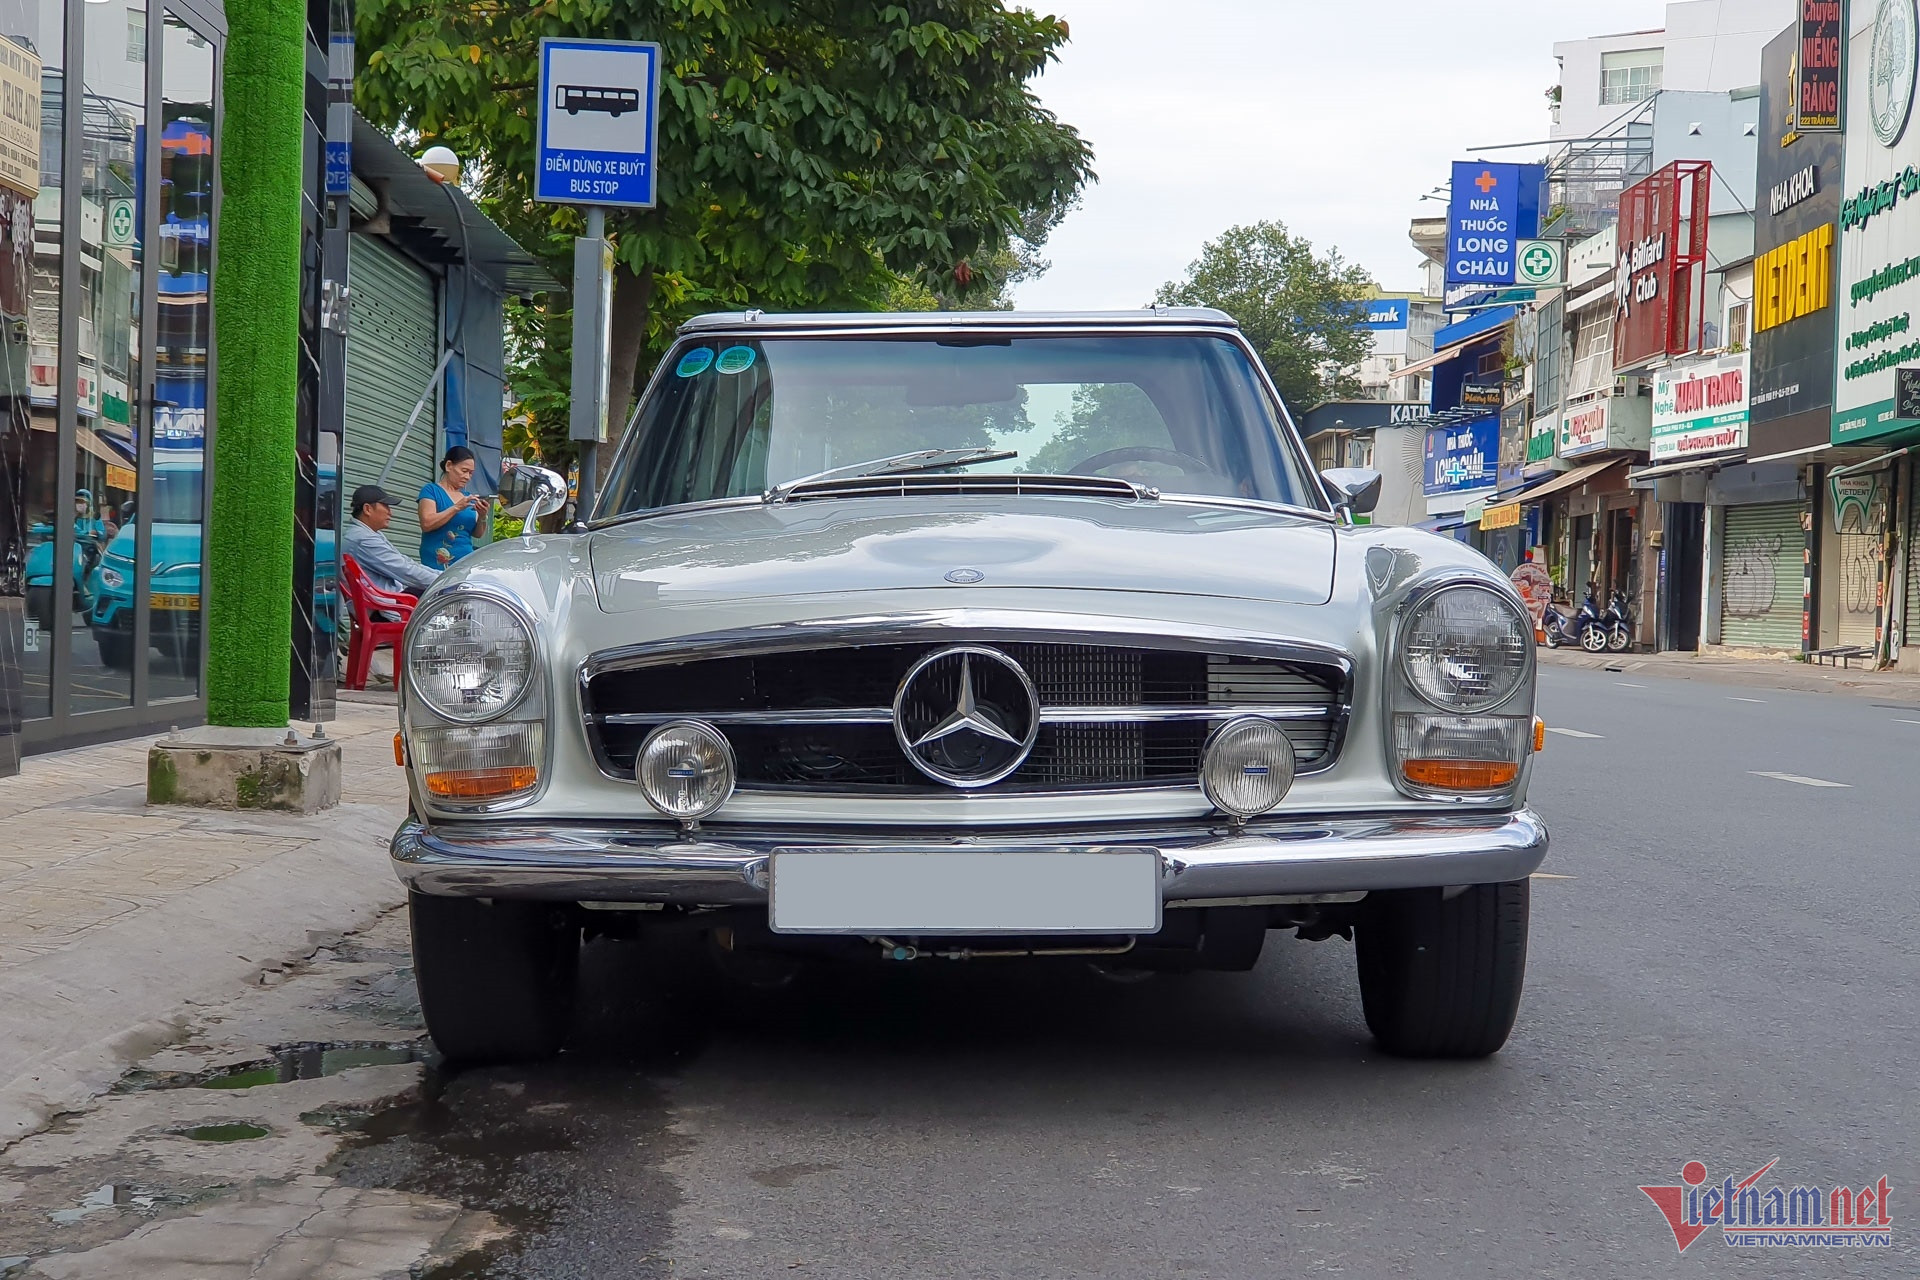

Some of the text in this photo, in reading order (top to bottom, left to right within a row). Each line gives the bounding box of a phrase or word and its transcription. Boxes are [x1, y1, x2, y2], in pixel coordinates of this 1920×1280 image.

[545, 152, 646, 176] ĐIỂM DỪNG XE BUÝT
[570, 179, 619, 195] BUS STOP
[1789, 165, 1815, 206] KHOA
[1470, 197, 1499, 211] NHÀ
[1460, 216, 1508, 232] THUỐC
[1457, 238, 1509, 253] LONG
[1632, 231, 1664, 273] Billiard
[1456, 257, 1509, 276] CHÂU
[1636, 271, 1657, 303] Club
[1755, 223, 1832, 333] VIETDENT
[1704, 369, 1743, 407] TRANG
[1654, 399, 1674, 416] Nghệ
[1838, 488, 1870, 496] VIETDENT
